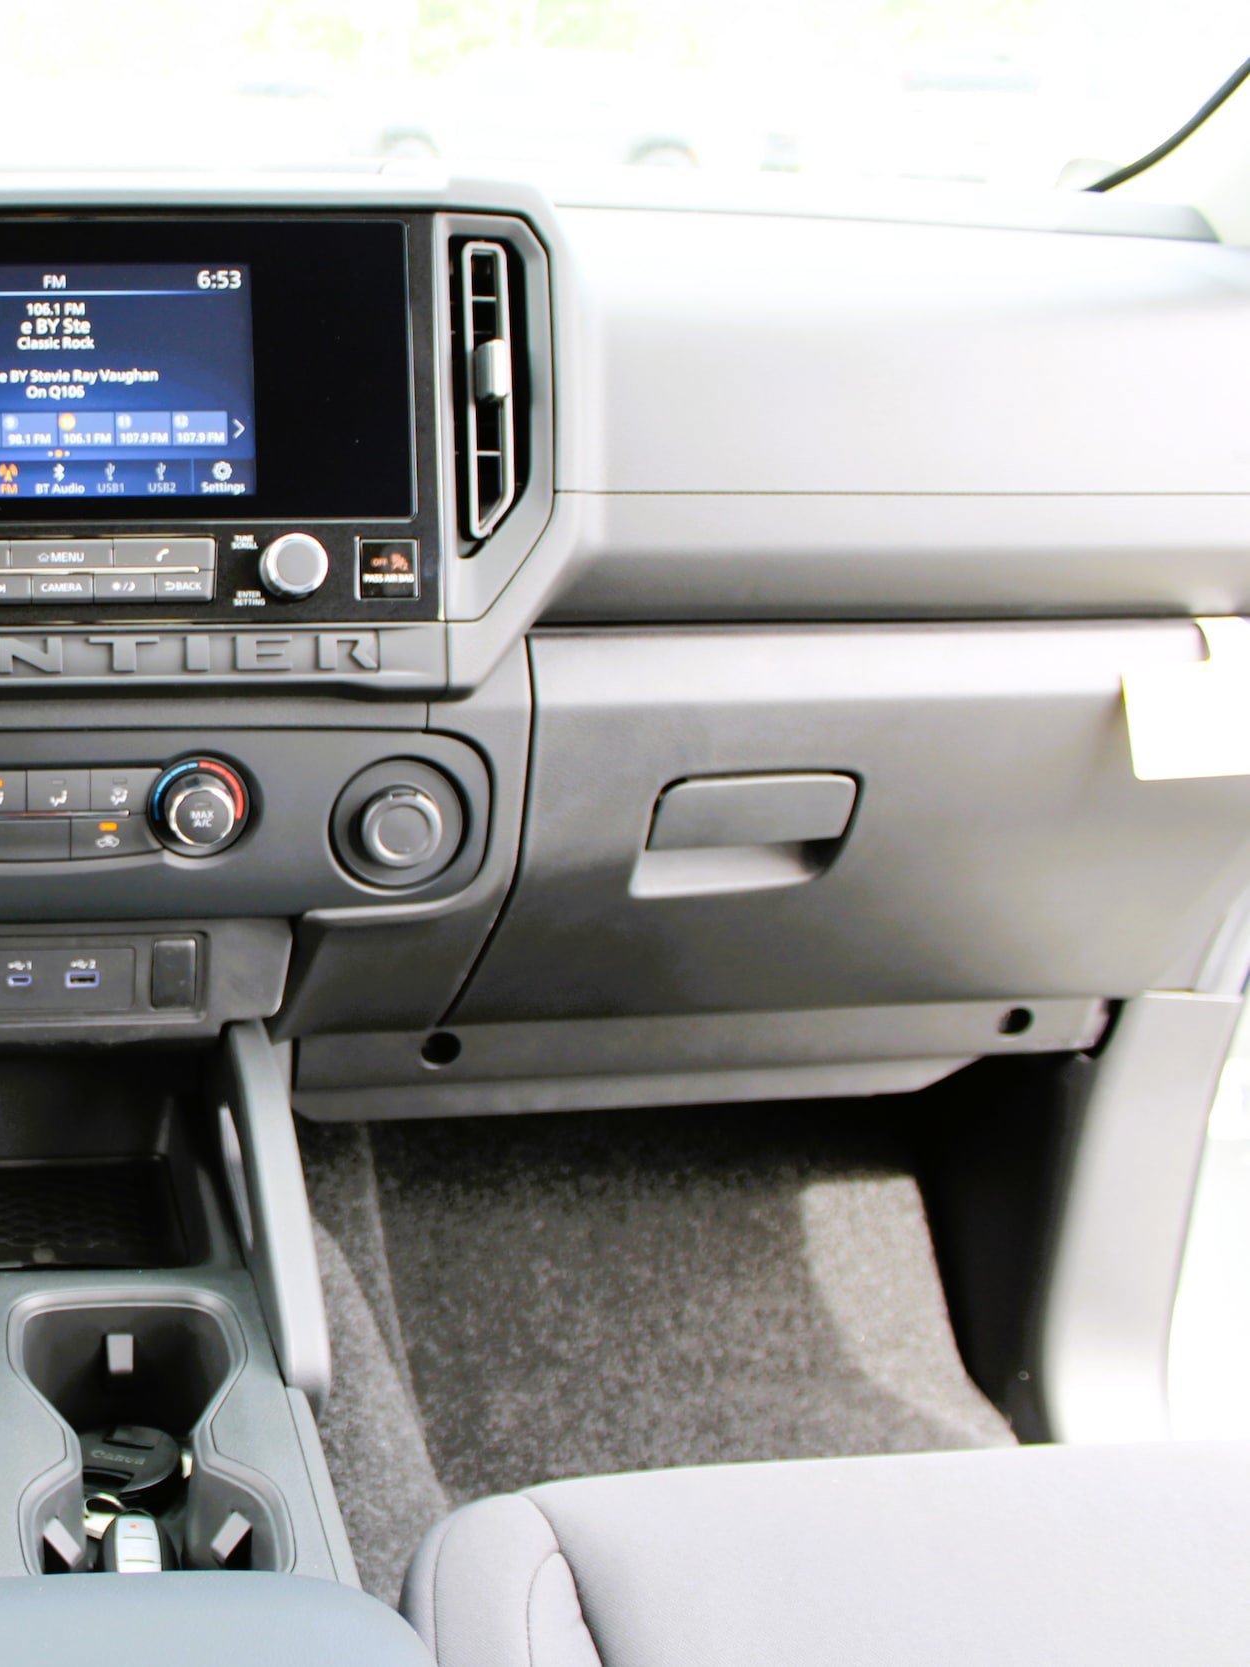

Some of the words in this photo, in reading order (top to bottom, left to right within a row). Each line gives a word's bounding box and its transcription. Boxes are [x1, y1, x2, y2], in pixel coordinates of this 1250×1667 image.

[42, 274, 67, 289] FM
[196, 269, 242, 289] 6:53
[26, 302, 60, 316] 106.1
[64, 302, 86, 315] FM
[20, 320, 32, 335] e
[35, 318, 60, 335] BY
[62, 318, 91, 335] Ste
[16, 336, 60, 350] Classic
[62, 336, 95, 350] Rock
[9, 369, 29, 383] BY
[30, 369, 71, 383] Stevie
[72, 369, 98, 385] Ray
[99, 368, 159, 385] Vaughan
[25, 385, 47, 399] On
[48, 385, 85, 400] Q106
[33, 434, 52, 445] FM
[93, 432, 112, 444] FM
[150, 432, 169, 443] FM
[206, 431, 225, 443] FM
[0, 483, 18, 495] FM
[35, 483, 50, 495] BT
[52, 482, 85, 495] Audio
[96, 482, 125, 494] USB1
[147, 482, 177, 493] USB2
[201, 480, 246, 496] Settings
[51, 552, 85, 563] MENU
[40, 583, 83, 593] CAMERA
[175, 581, 202, 591] BACK
[190, 811, 215, 820] MAX
[193, 819, 213, 828] A/C
